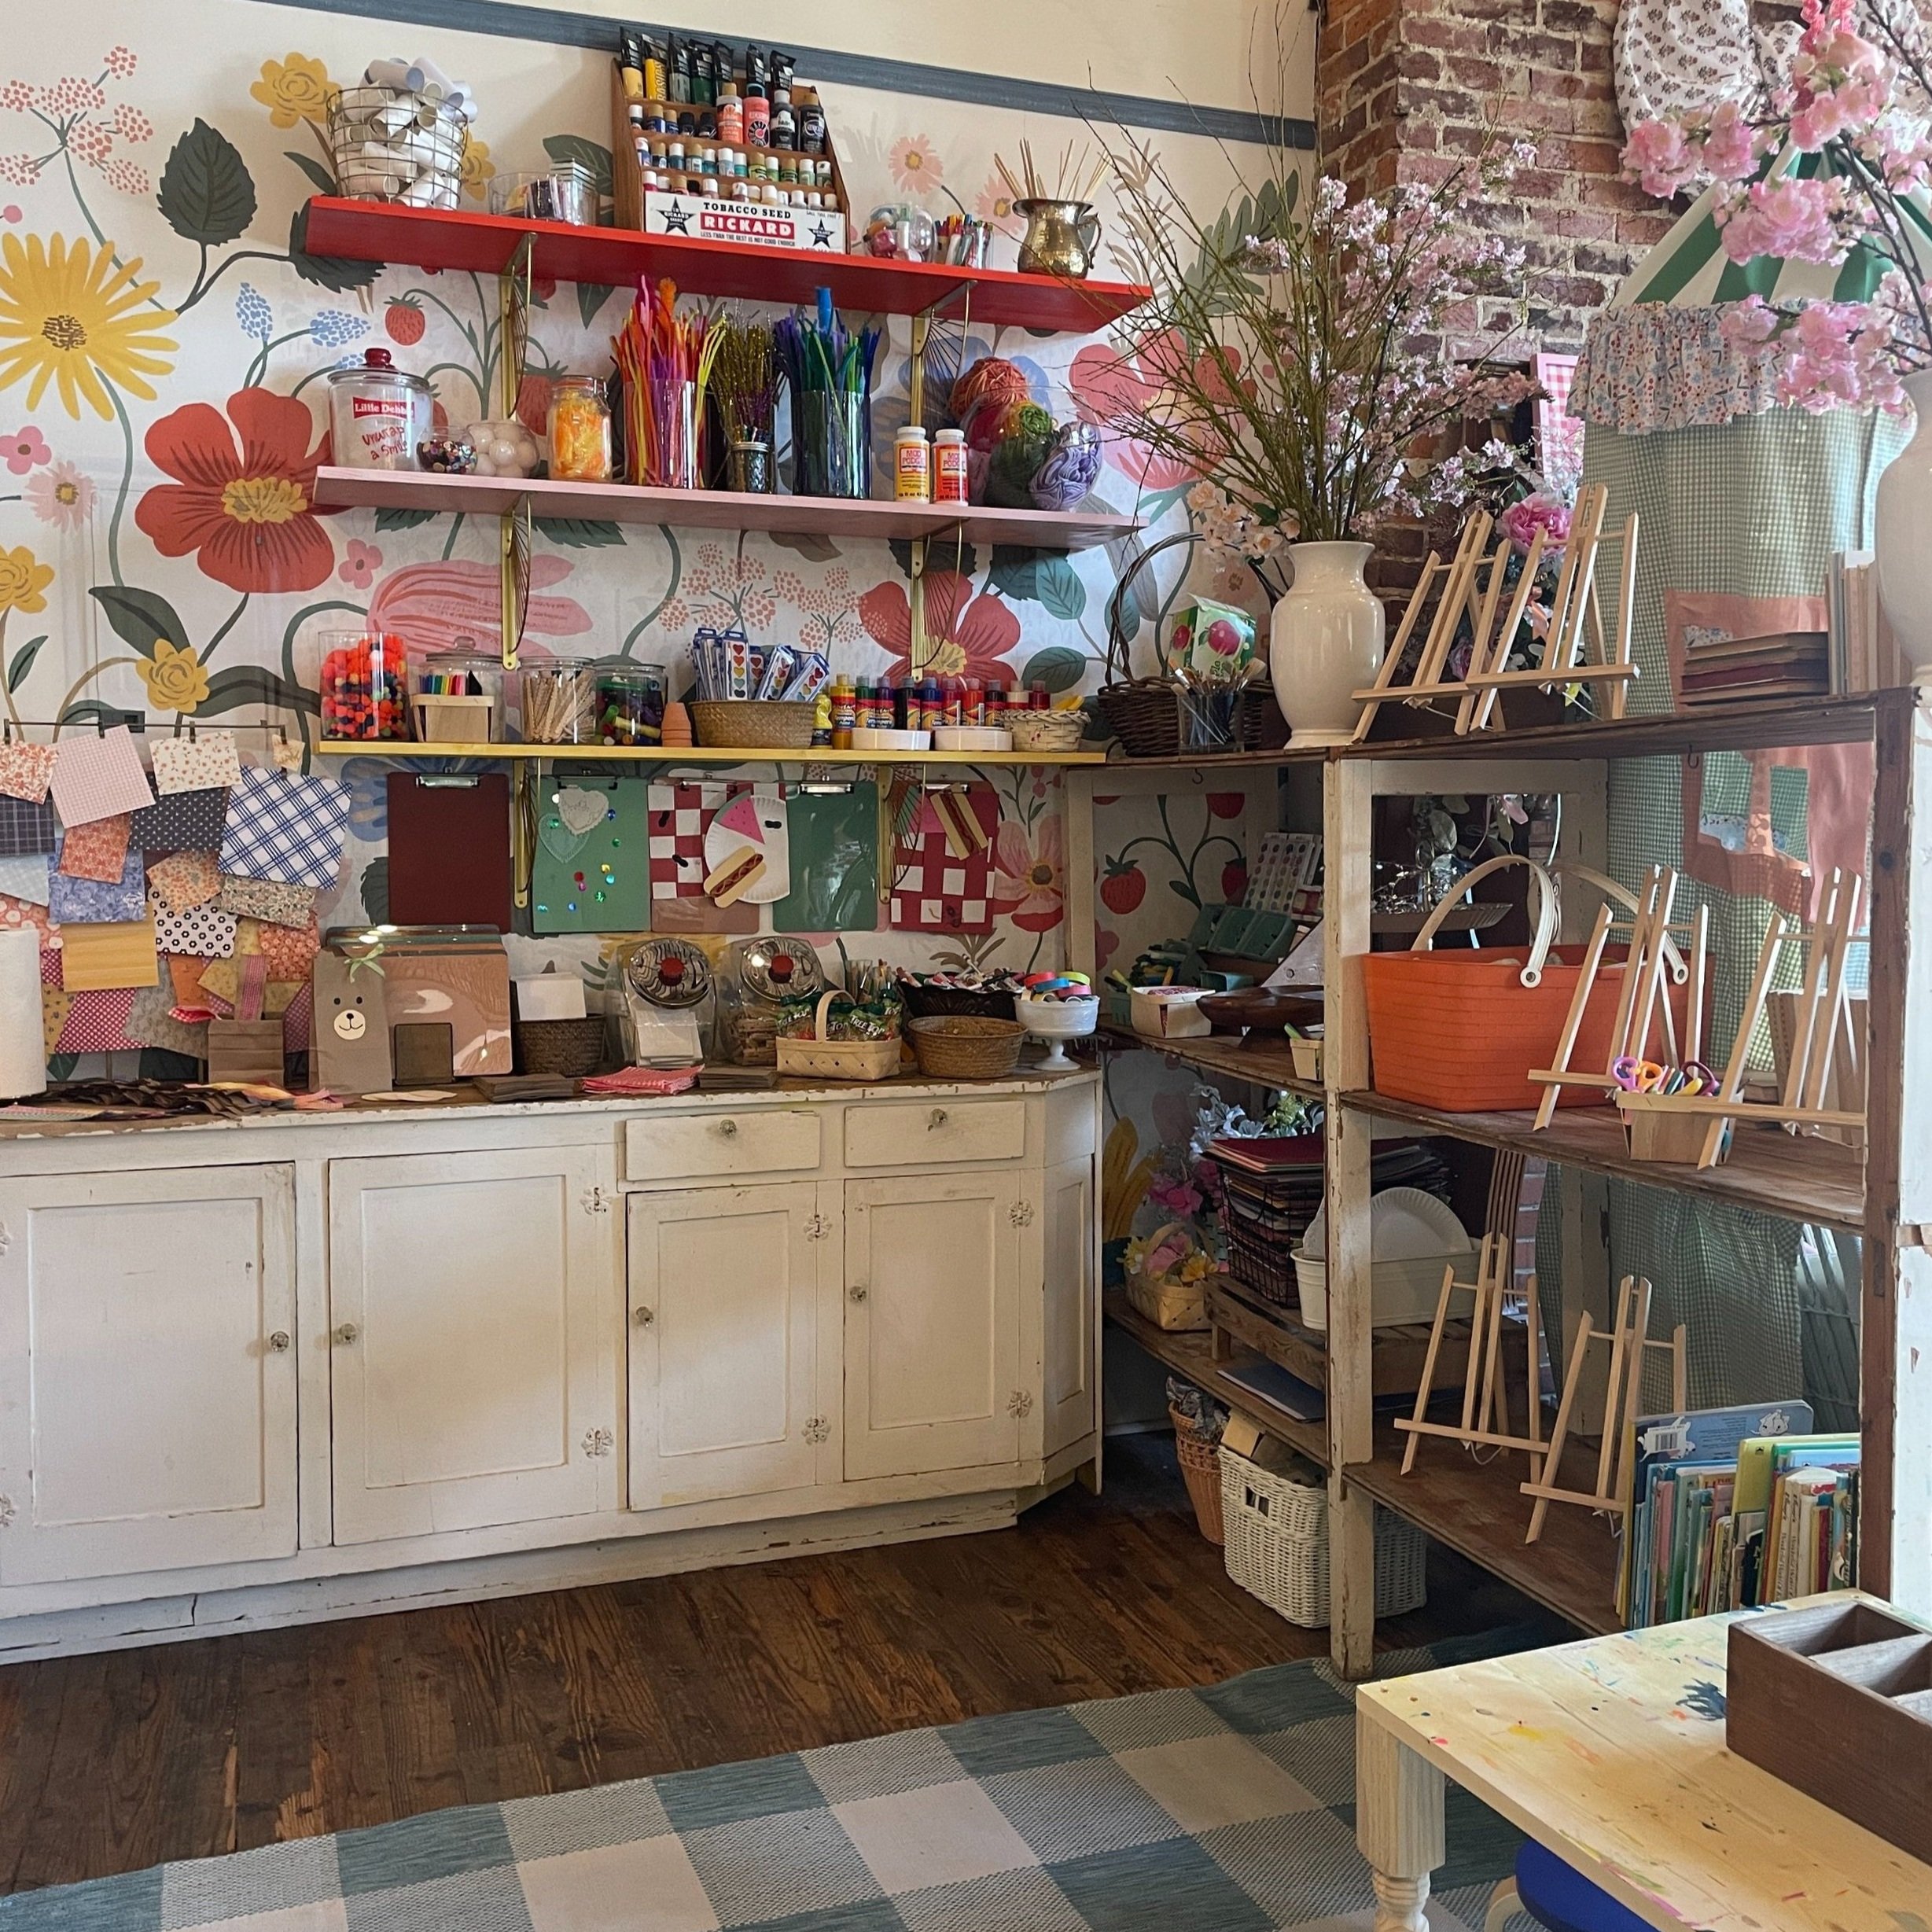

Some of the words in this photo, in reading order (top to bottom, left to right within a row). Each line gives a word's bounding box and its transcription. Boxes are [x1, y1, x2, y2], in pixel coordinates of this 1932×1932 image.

[703, 202, 758, 215] TOBACCO
[762, 208, 791, 219] SEED
[704, 215, 792, 236] RICKARD
[355, 403, 381, 413] Little
[850, 1014, 867, 1029] TREE
